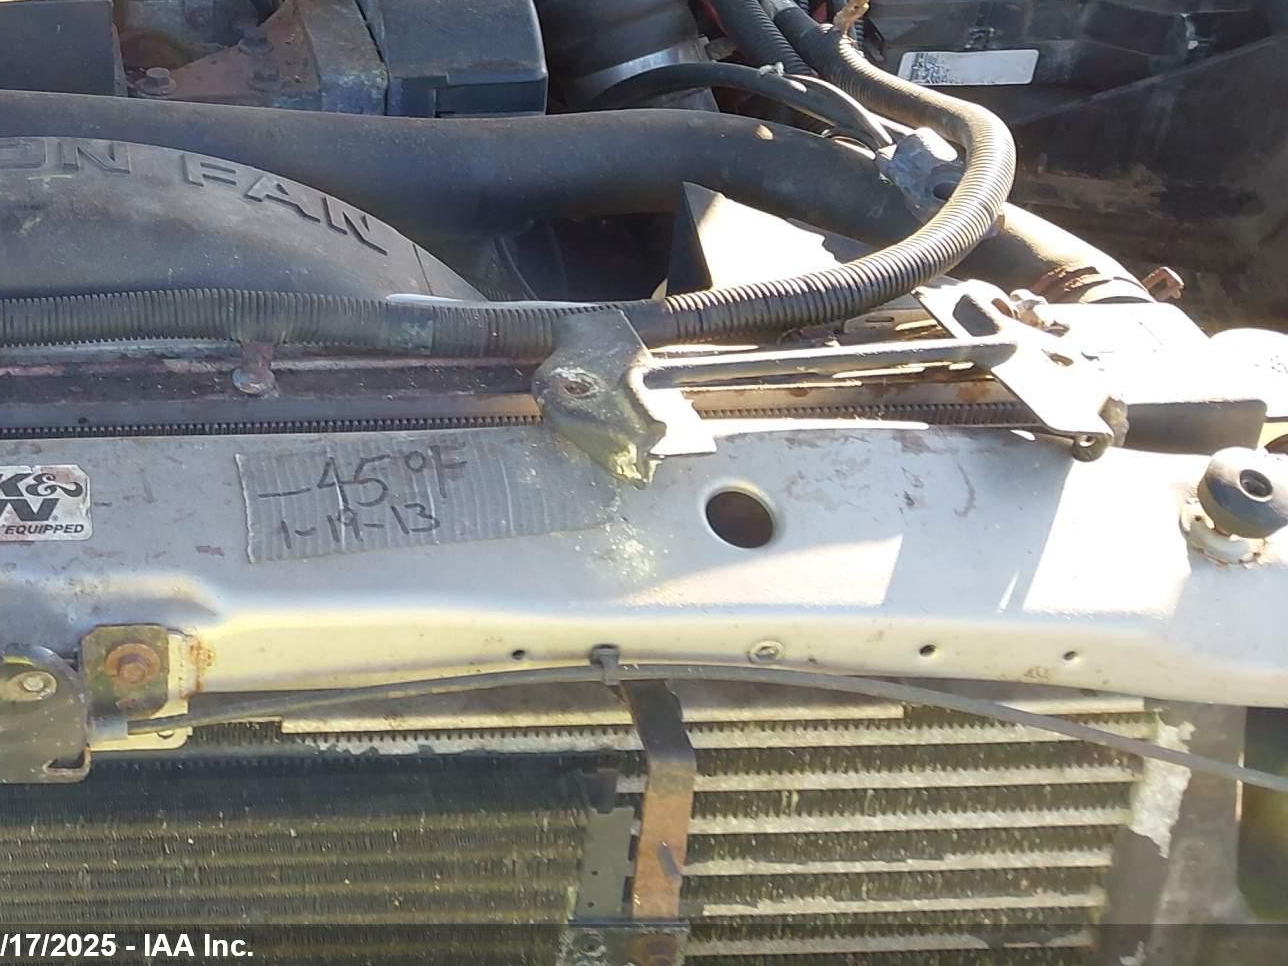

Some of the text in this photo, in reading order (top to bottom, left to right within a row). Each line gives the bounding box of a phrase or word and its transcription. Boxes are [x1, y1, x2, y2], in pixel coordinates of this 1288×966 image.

[182, 153, 388, 256] FAN
[4, 524, 85, 535] EQUIPPED
[281, 502, 441, 549] 1-19-13
